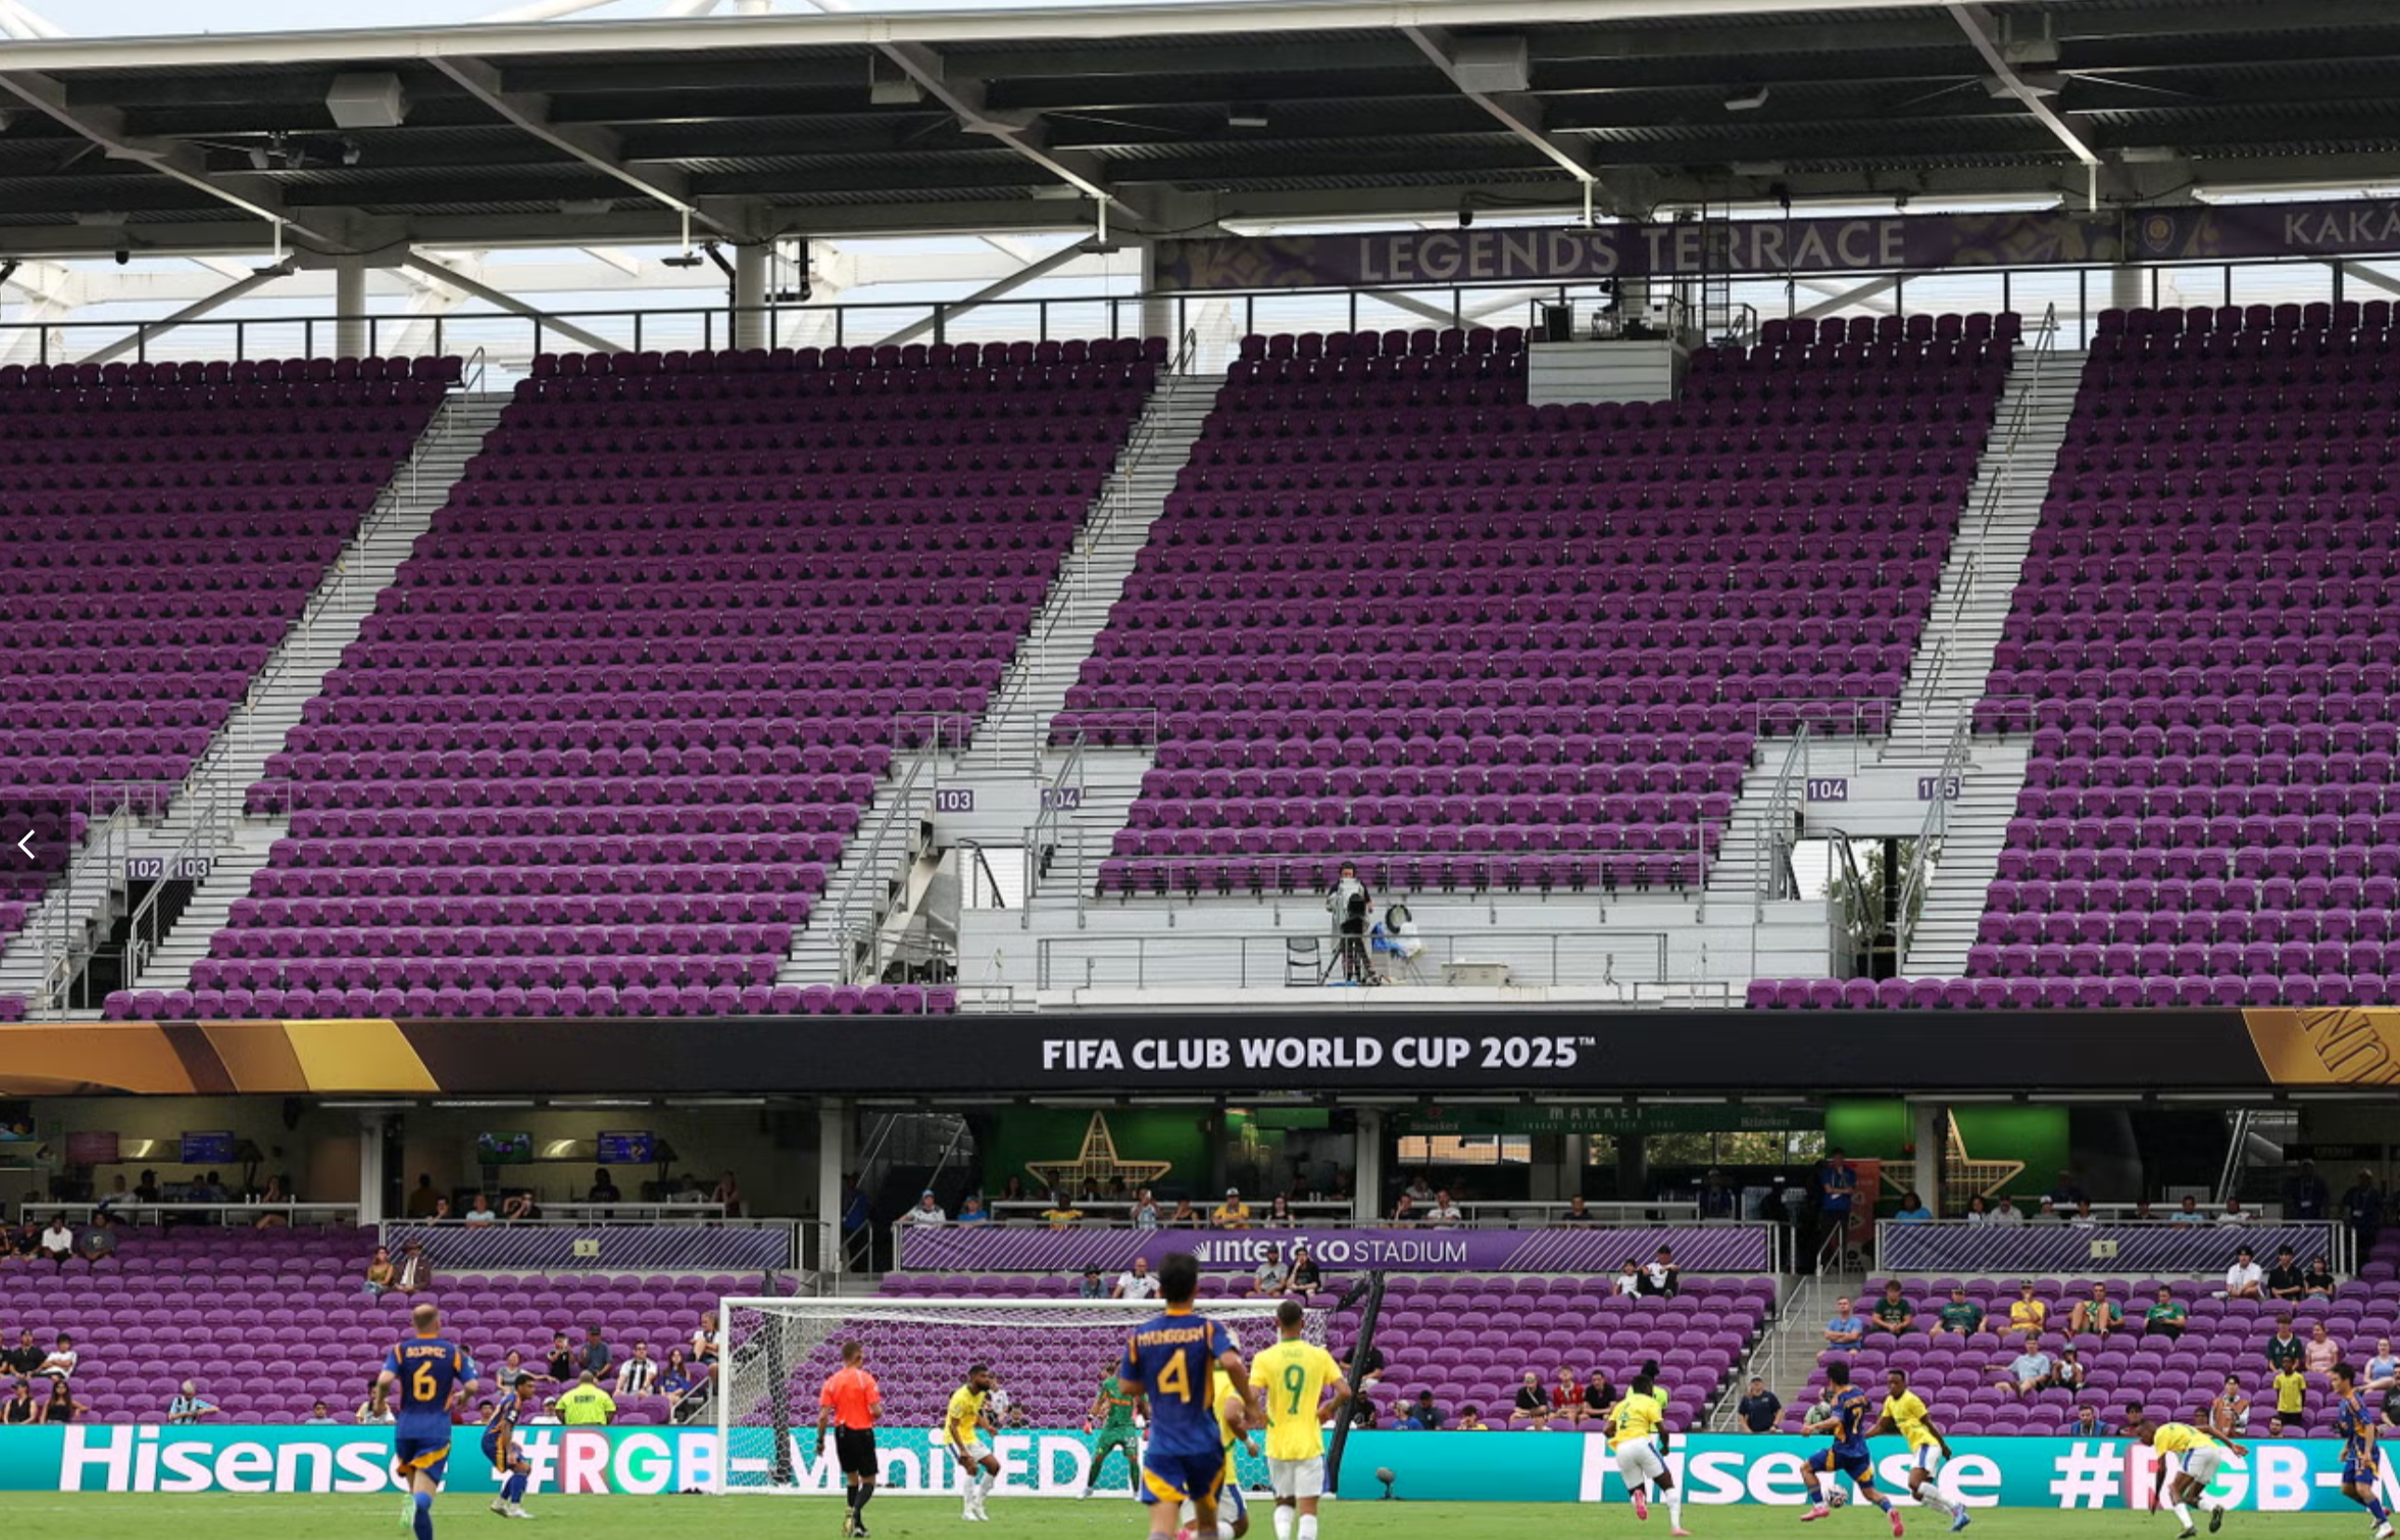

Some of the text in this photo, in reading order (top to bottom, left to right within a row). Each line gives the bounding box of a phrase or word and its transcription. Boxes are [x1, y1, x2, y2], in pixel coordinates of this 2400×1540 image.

[1360, 220, 1905, 282] LEGENDS TERRACE
[937, 792, 971, 809] 103
[1810, 781, 1844, 798] 104
[128, 861, 161, 878] 102
[176, 861, 208, 878] 103
[1043, 1039, 1124, 1070] FIFA
[1131, 1038, 1231, 1070] CLUB
[1239, 1036, 1382, 1069] WORLD
[1391, 1036, 1471, 1068] CUP
[1353, 1239, 1467, 1263] STADIUM
[413, 1361, 437, 1402] 6
[1157, 1348, 1191, 1404] 4
[1284, 1363, 1305, 1415] 9
